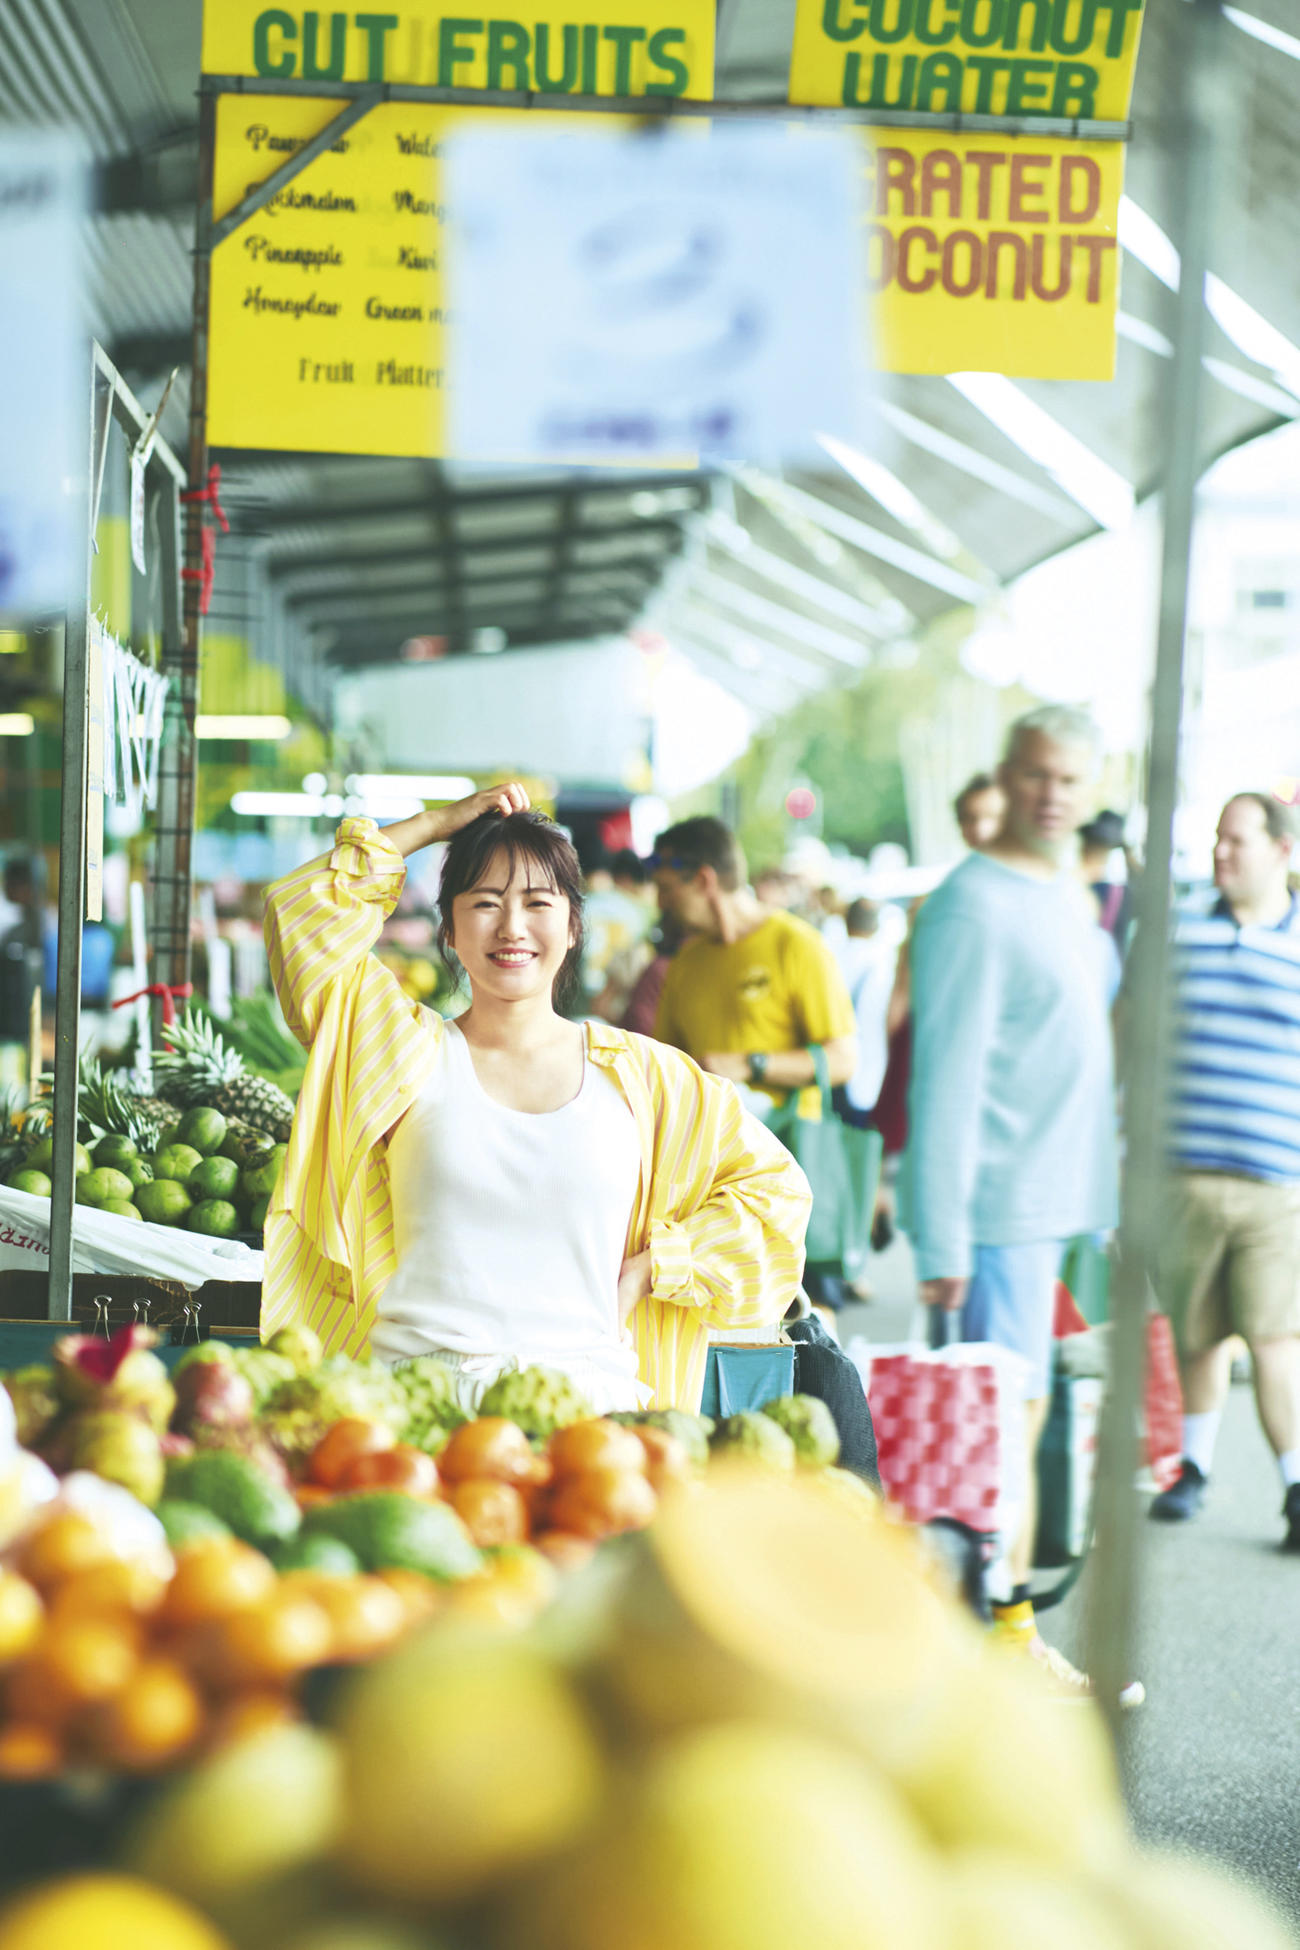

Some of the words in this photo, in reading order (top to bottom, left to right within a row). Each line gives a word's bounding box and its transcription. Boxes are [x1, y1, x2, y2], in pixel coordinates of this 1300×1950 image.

[253, 9, 399, 83] CUT
[437, 18, 690, 97] FRUITS
[821, 0, 1143, 58] COCONUT
[842, 51, 1099, 119] WATER
[866, 146, 1102, 224] RATED
[244, 235, 343, 273] Pineapple
[398, 246, 437, 271] Kiwi
[864, 222, 1117, 304] OCONUT
[242, 285, 341, 320] Honeydew
[364, 296, 423, 322] Green
[299, 357, 355, 384] Fruit
[376, 357, 449, 388] Platter
